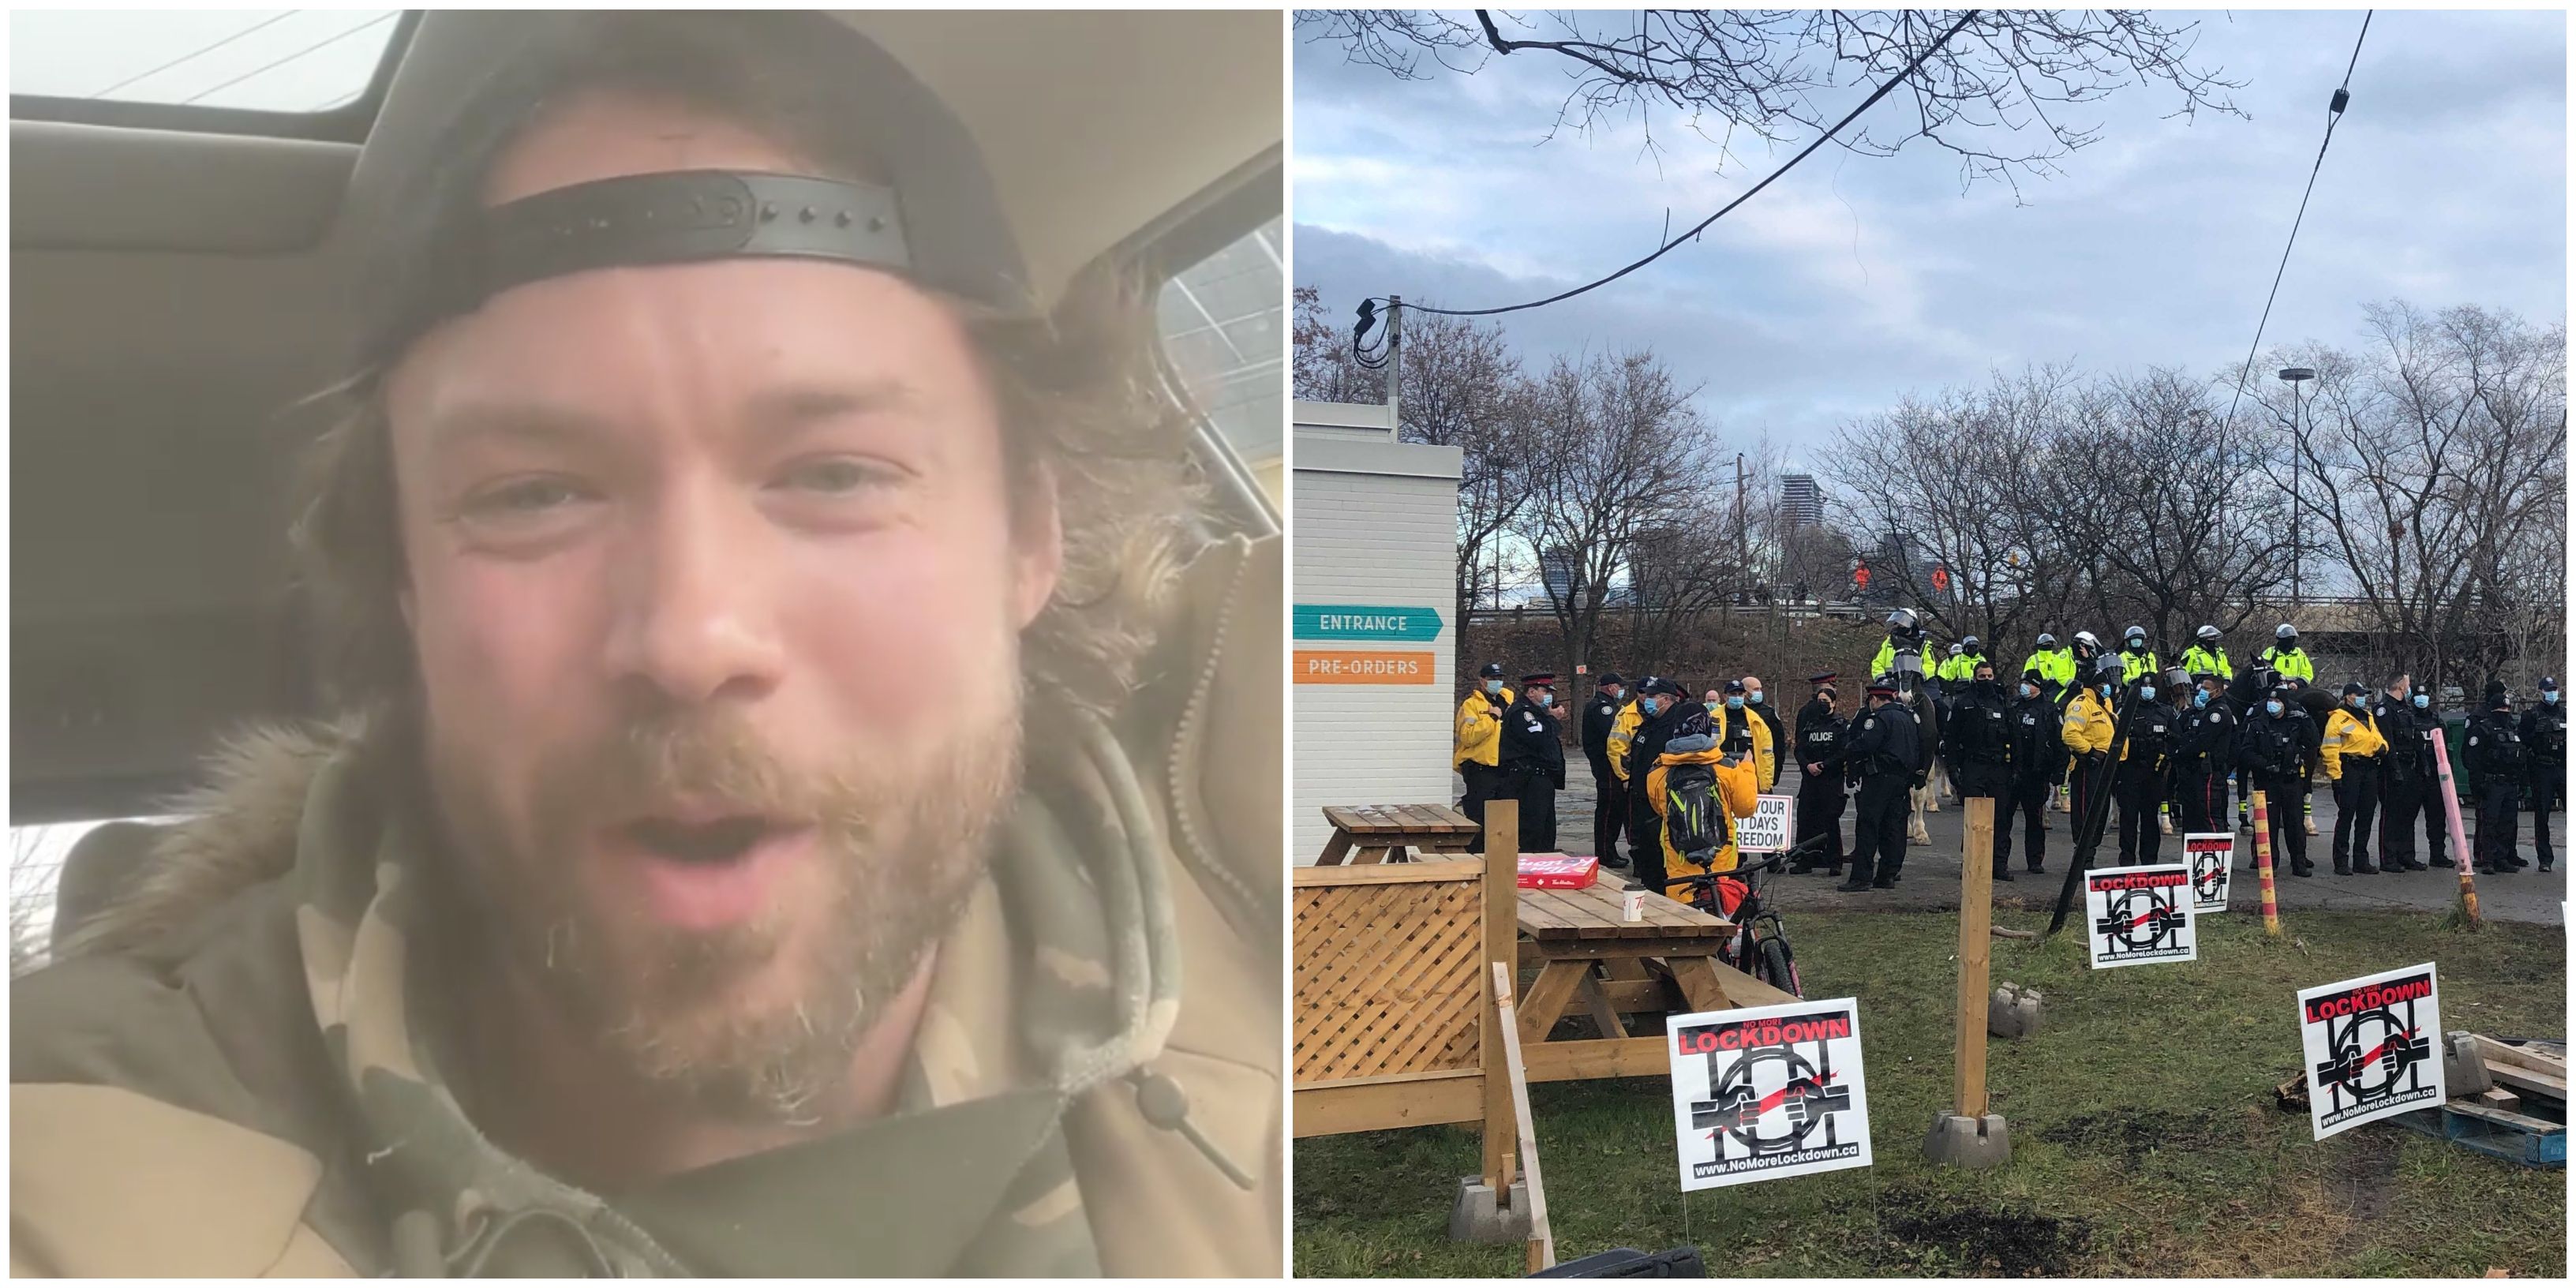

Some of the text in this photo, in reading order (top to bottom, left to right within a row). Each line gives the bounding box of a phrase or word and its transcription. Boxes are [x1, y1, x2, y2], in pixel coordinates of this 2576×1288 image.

[1320, 615, 1407, 631] ENTRANCE
[1309, 659, 1418, 675] PRE-ORDERS
[1809, 732, 1833, 742] POLICE
[1749, 816, 1778, 831] DAYS
[1735, 831, 1784, 847] REEDOM
[2187, 841, 2231, 852] LOCKDOWN
[2091, 874, 2187, 892] LOCKDOWN
[2098, 949, 2189, 961] www.NoMoreLockdown.ca
[2307, 979, 2430, 1023] LOCKDOWN
[1758, 1018, 1782, 1027] MORE
[1679, 1018, 1849, 1055] LOCKDOWN
[2322, 1088, 2436, 1127] www.NoMoreLockdown.ca
[1695, 1145, 1858, 1177] www.NoMoreLockdown.ca
